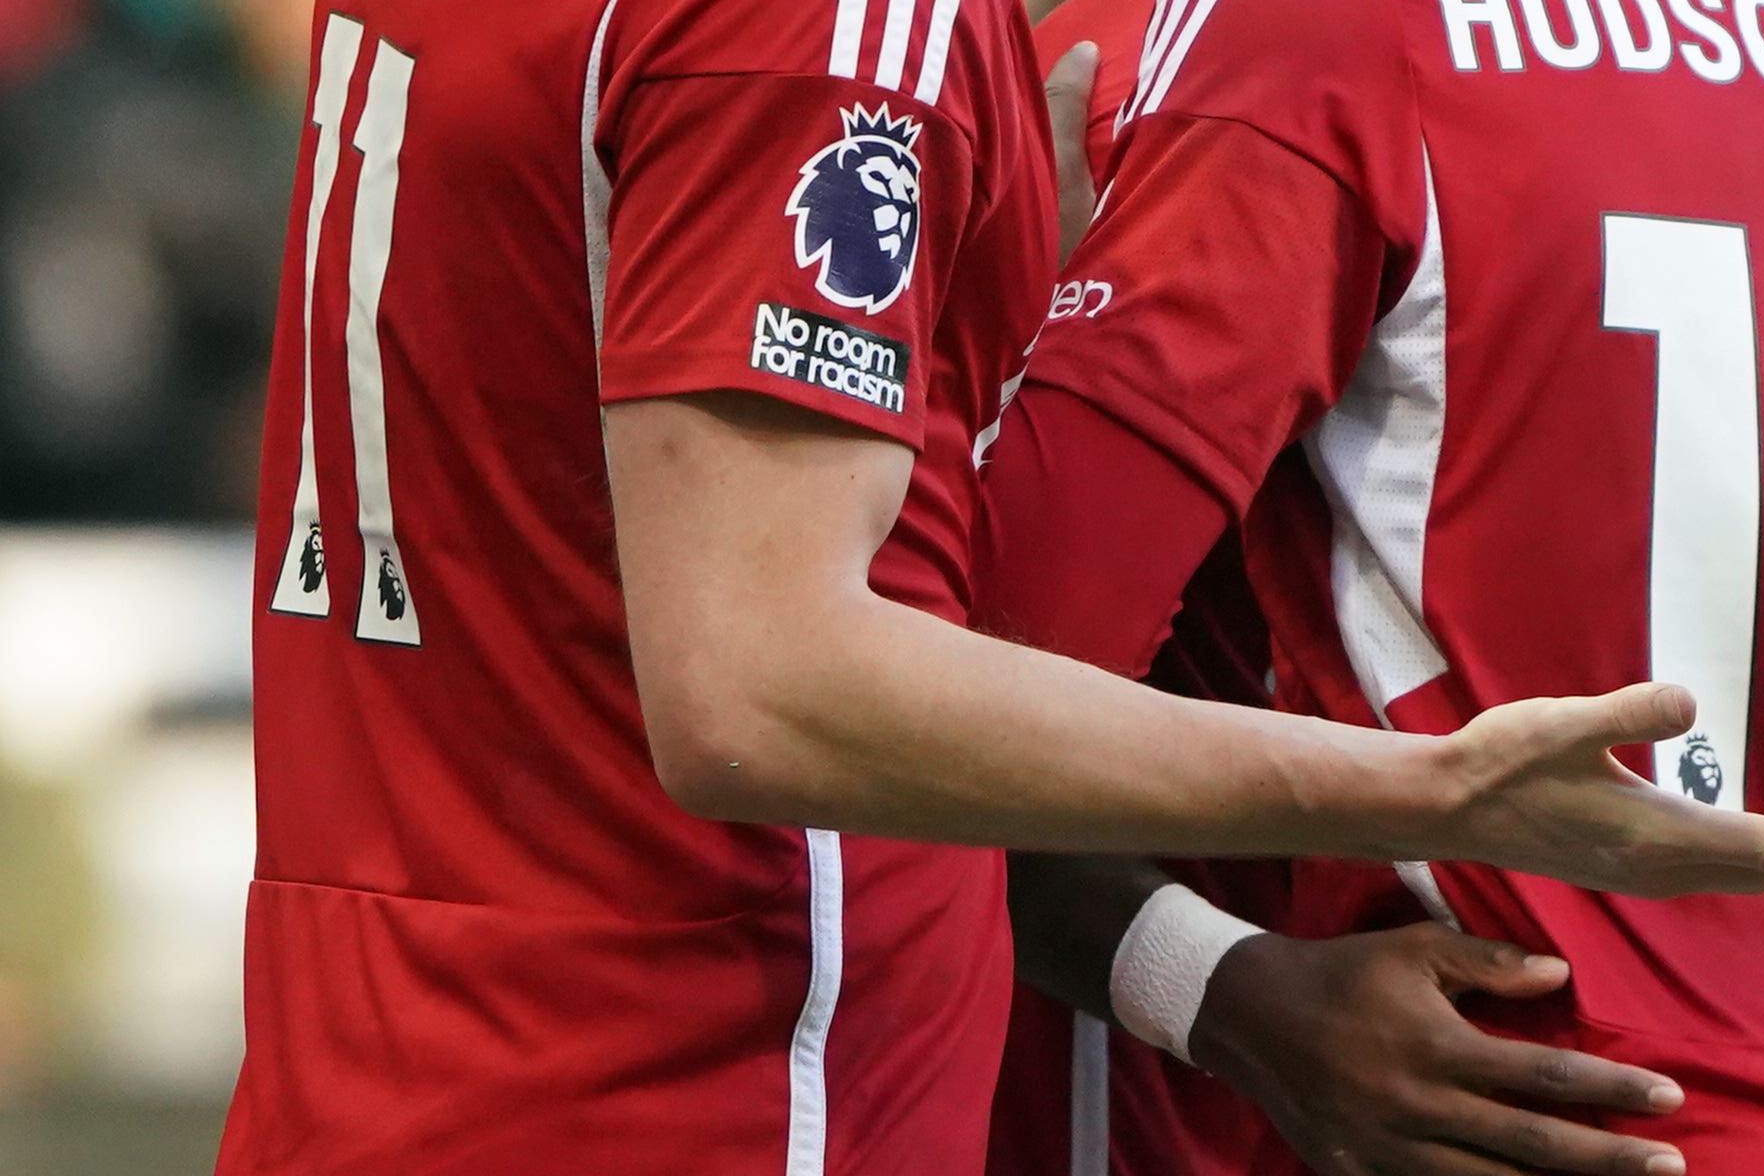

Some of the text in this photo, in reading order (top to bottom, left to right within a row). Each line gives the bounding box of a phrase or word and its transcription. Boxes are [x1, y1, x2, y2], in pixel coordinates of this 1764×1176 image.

[268, 10, 422, 648] 11
[755, 303, 896, 376] No room
[751, 335, 904, 413] for racism
